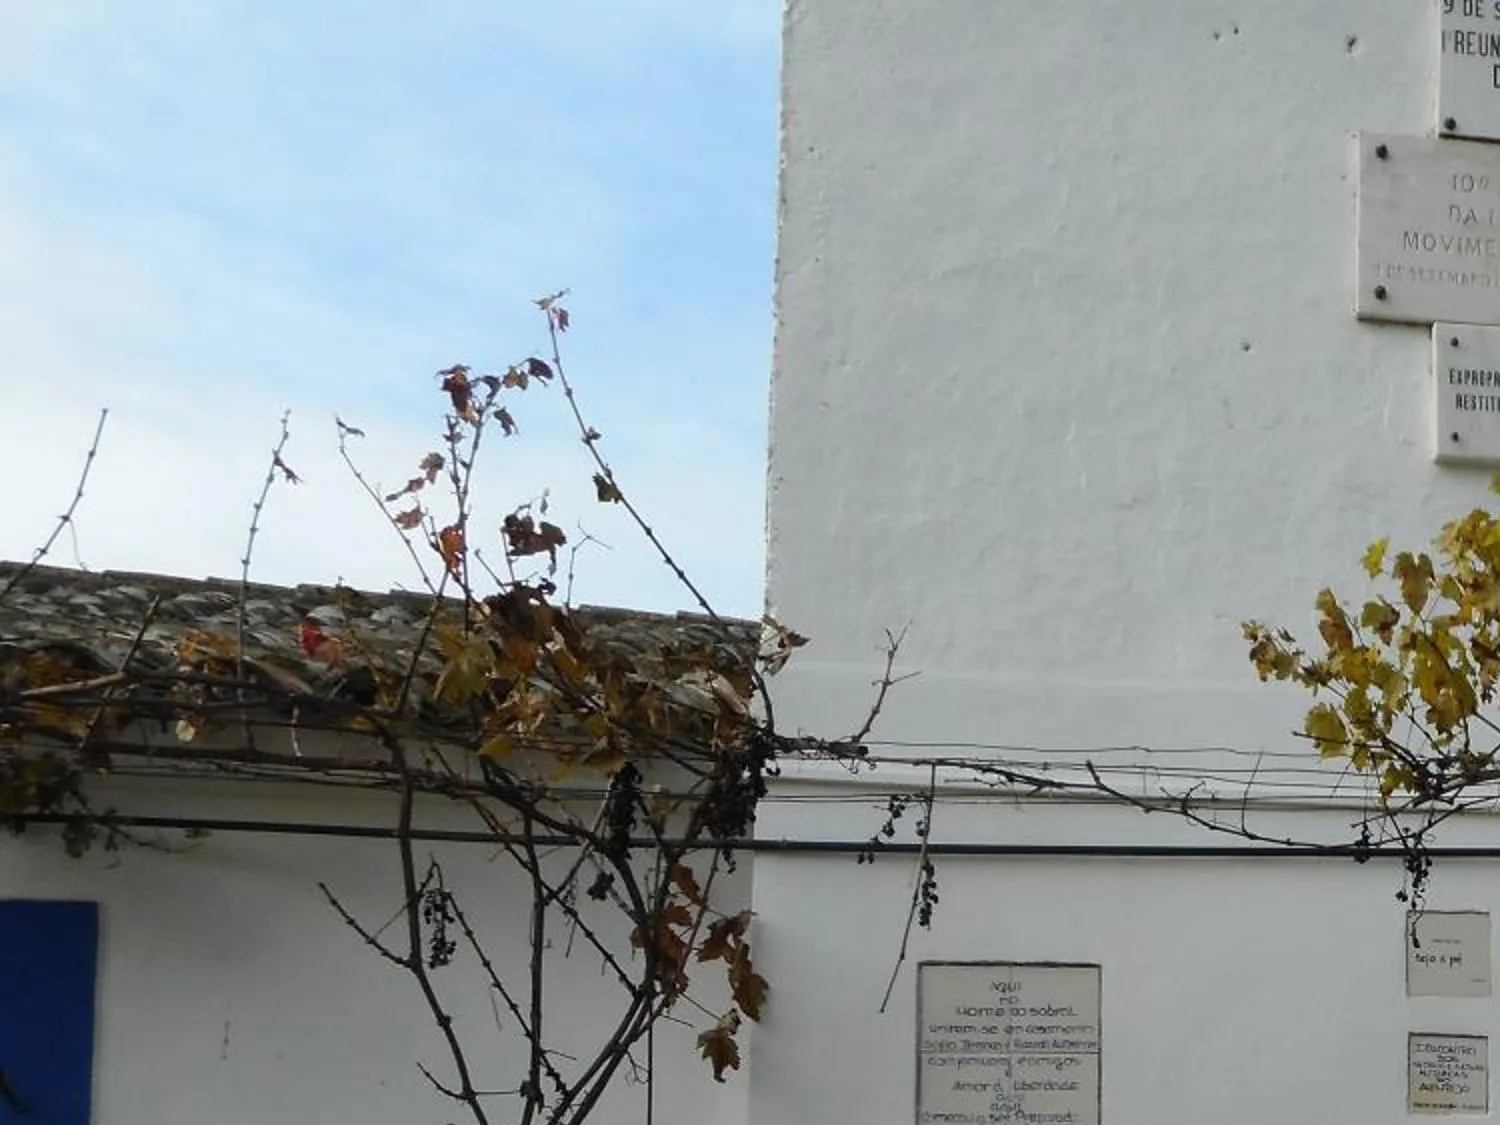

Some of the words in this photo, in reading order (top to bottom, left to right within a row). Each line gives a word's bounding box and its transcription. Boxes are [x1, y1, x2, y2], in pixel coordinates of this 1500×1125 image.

[1443, 0, 1453, 14] 9
[1463, 0, 1484, 18] DE
[1448, 203, 1480, 226] DA
